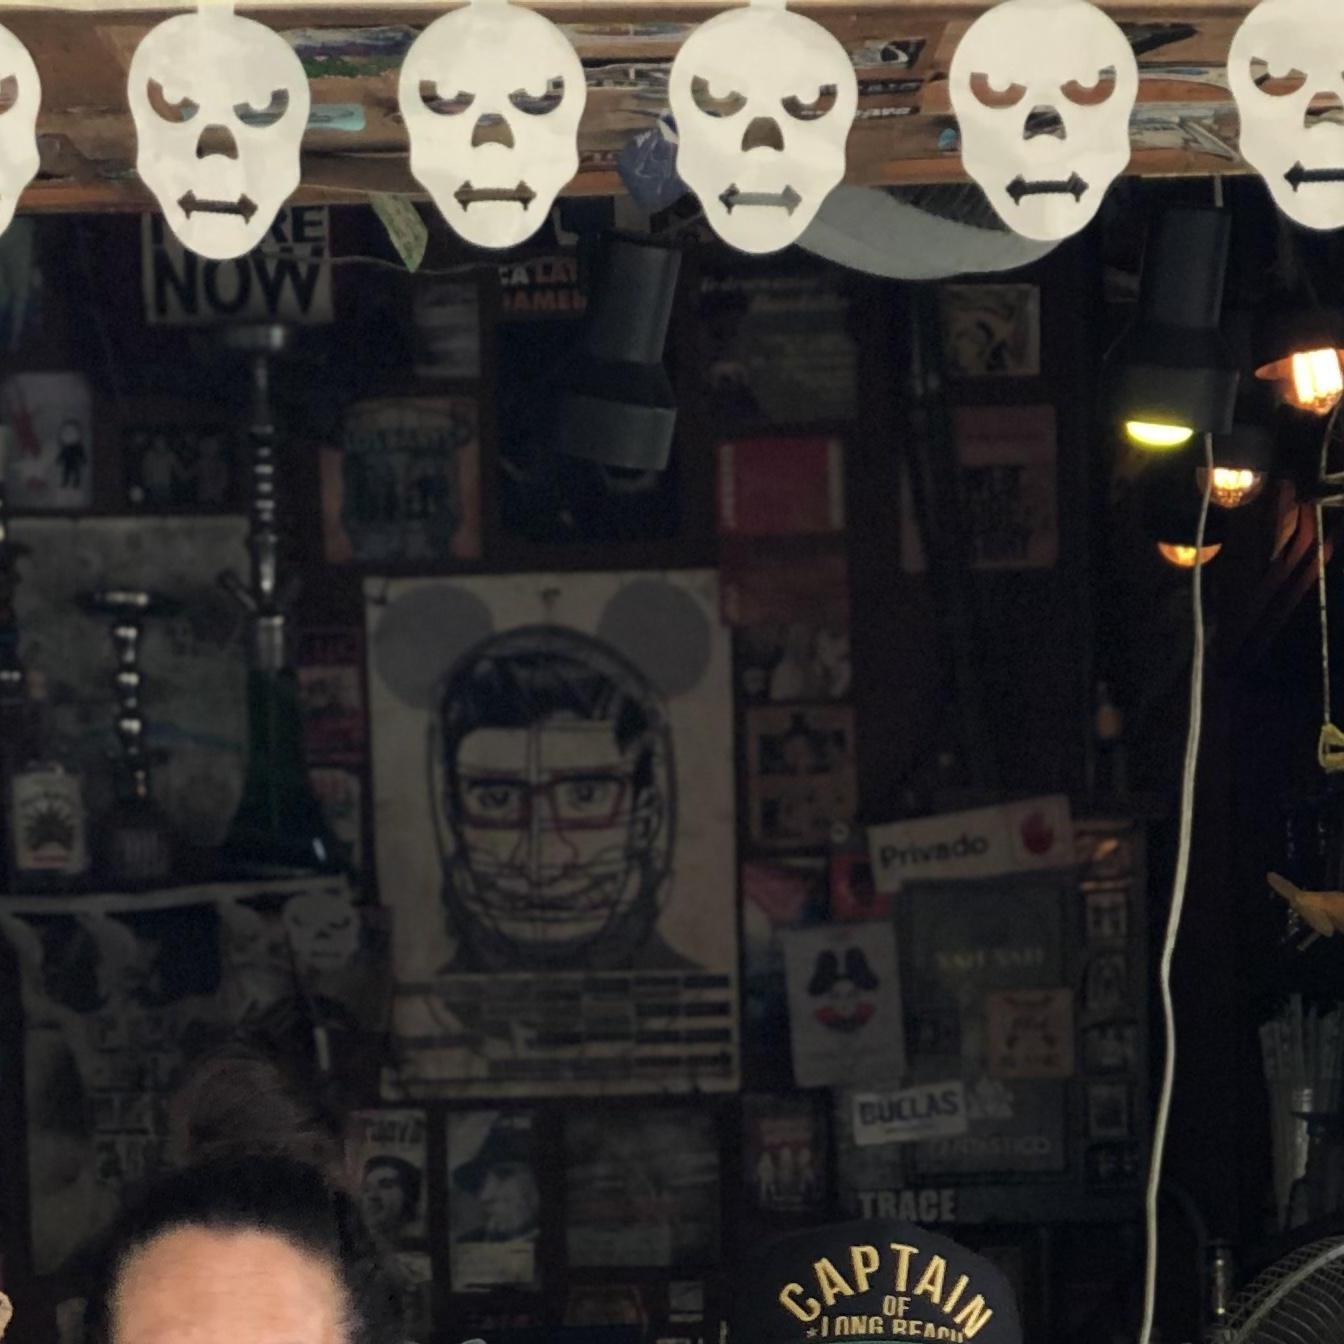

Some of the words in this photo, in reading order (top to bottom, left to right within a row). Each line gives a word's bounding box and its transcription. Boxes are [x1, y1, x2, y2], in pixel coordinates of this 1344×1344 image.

[154, 246, 322, 316] NOW
[880, 831, 989, 869] Privado
[858, 1190, 956, 1221] TRACE
[778, 1243, 994, 1339] CAPTAIN
[882, 1295, 912, 1317] OF
